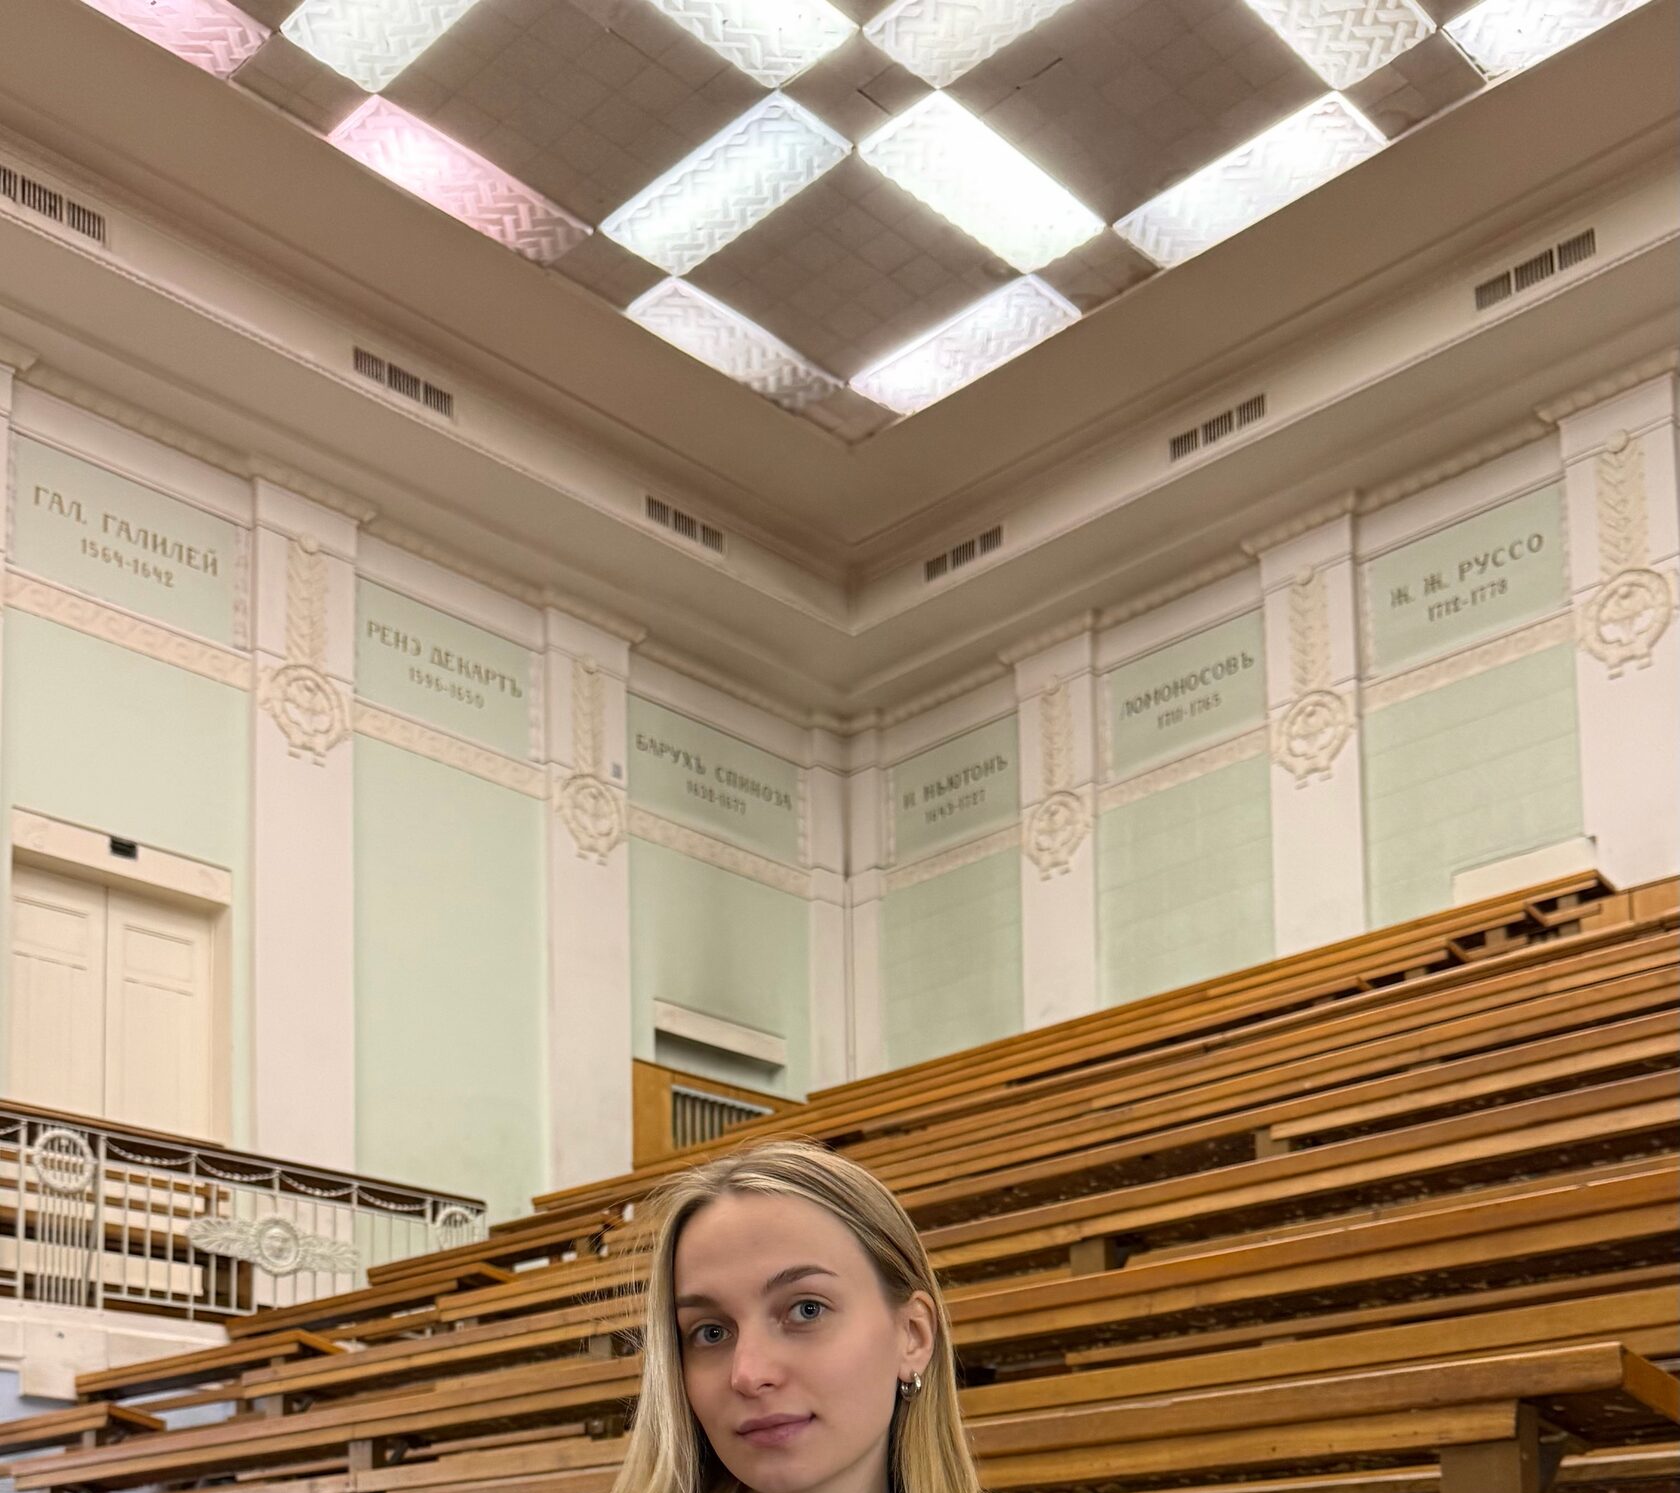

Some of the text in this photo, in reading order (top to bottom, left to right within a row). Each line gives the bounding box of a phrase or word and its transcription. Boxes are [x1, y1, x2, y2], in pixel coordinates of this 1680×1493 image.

[33, 485, 218, 577] ГАЛ. ГАЛИЛЕЙ
[81, 538, 174, 588] 1564-1642
[1458, 533, 1544, 582] РУССО
[1427, 577, 1508, 622] 1712-1778
[366, 620, 523, 698] РЕНЭ ДЕКАРТЪ
[714, 766, 793, 811] СПИНОЗА
